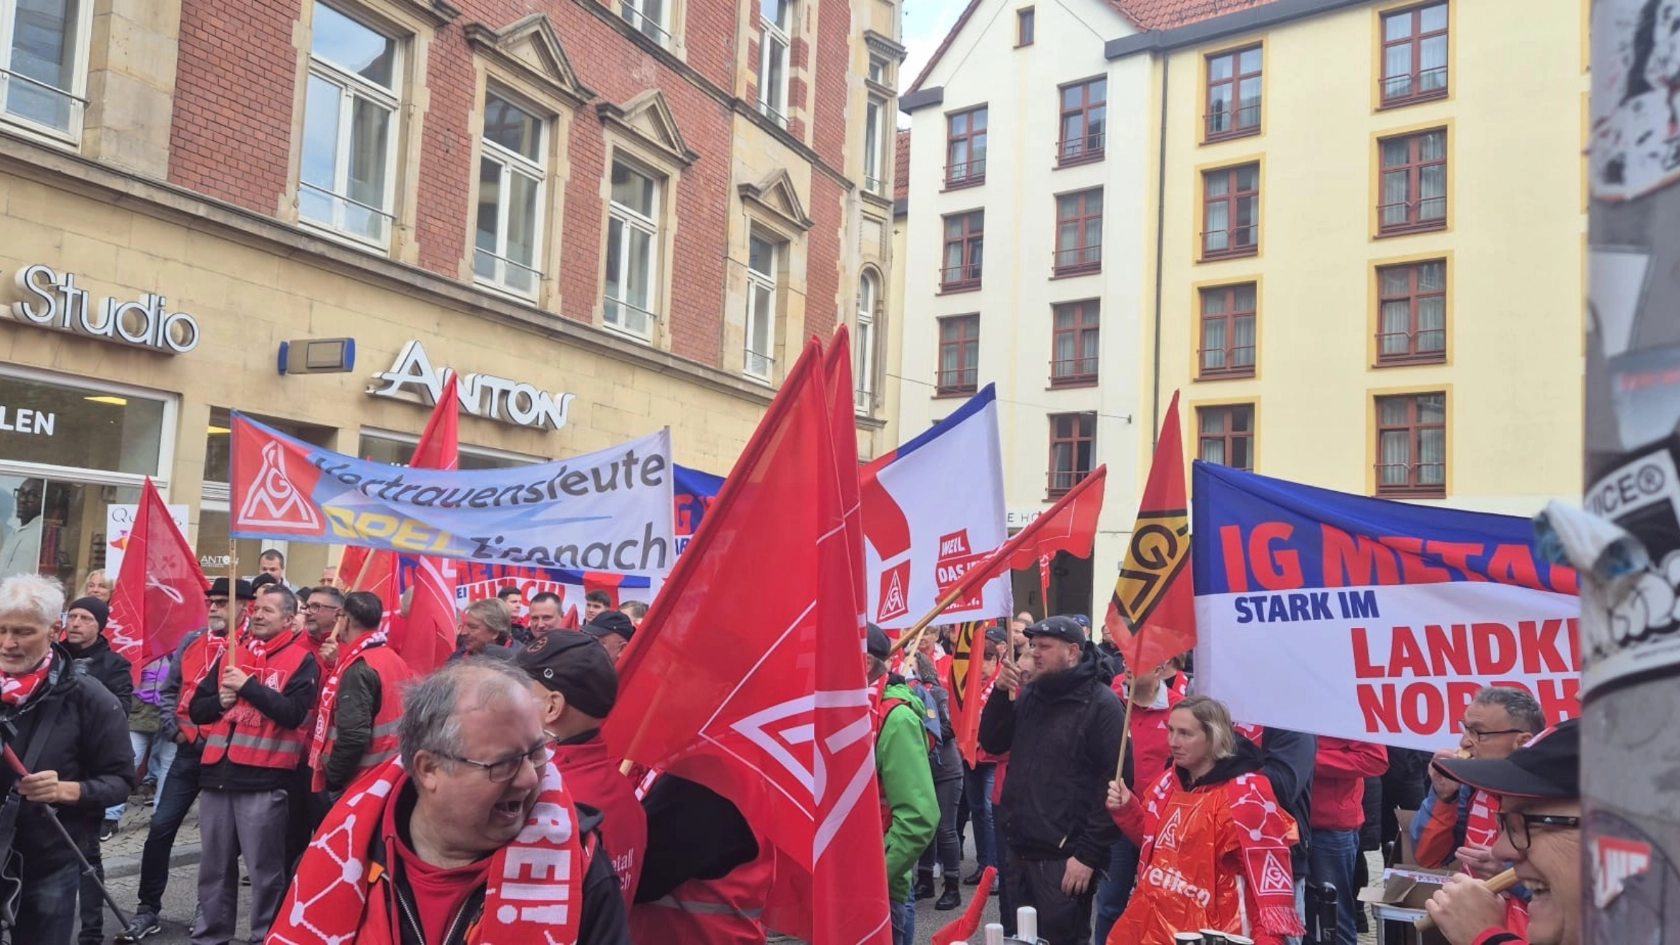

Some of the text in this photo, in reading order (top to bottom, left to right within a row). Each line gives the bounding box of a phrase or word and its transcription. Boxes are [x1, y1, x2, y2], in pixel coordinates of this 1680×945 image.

[20, 264, 200, 353] Studio
[942, 537, 966, 557] WEIL
[1220, 522, 1303, 593] IG
[938, 564, 965, 583] DAS
[457, 587, 467, 598] EI
[1235, 591, 1379, 623] STARK IM
